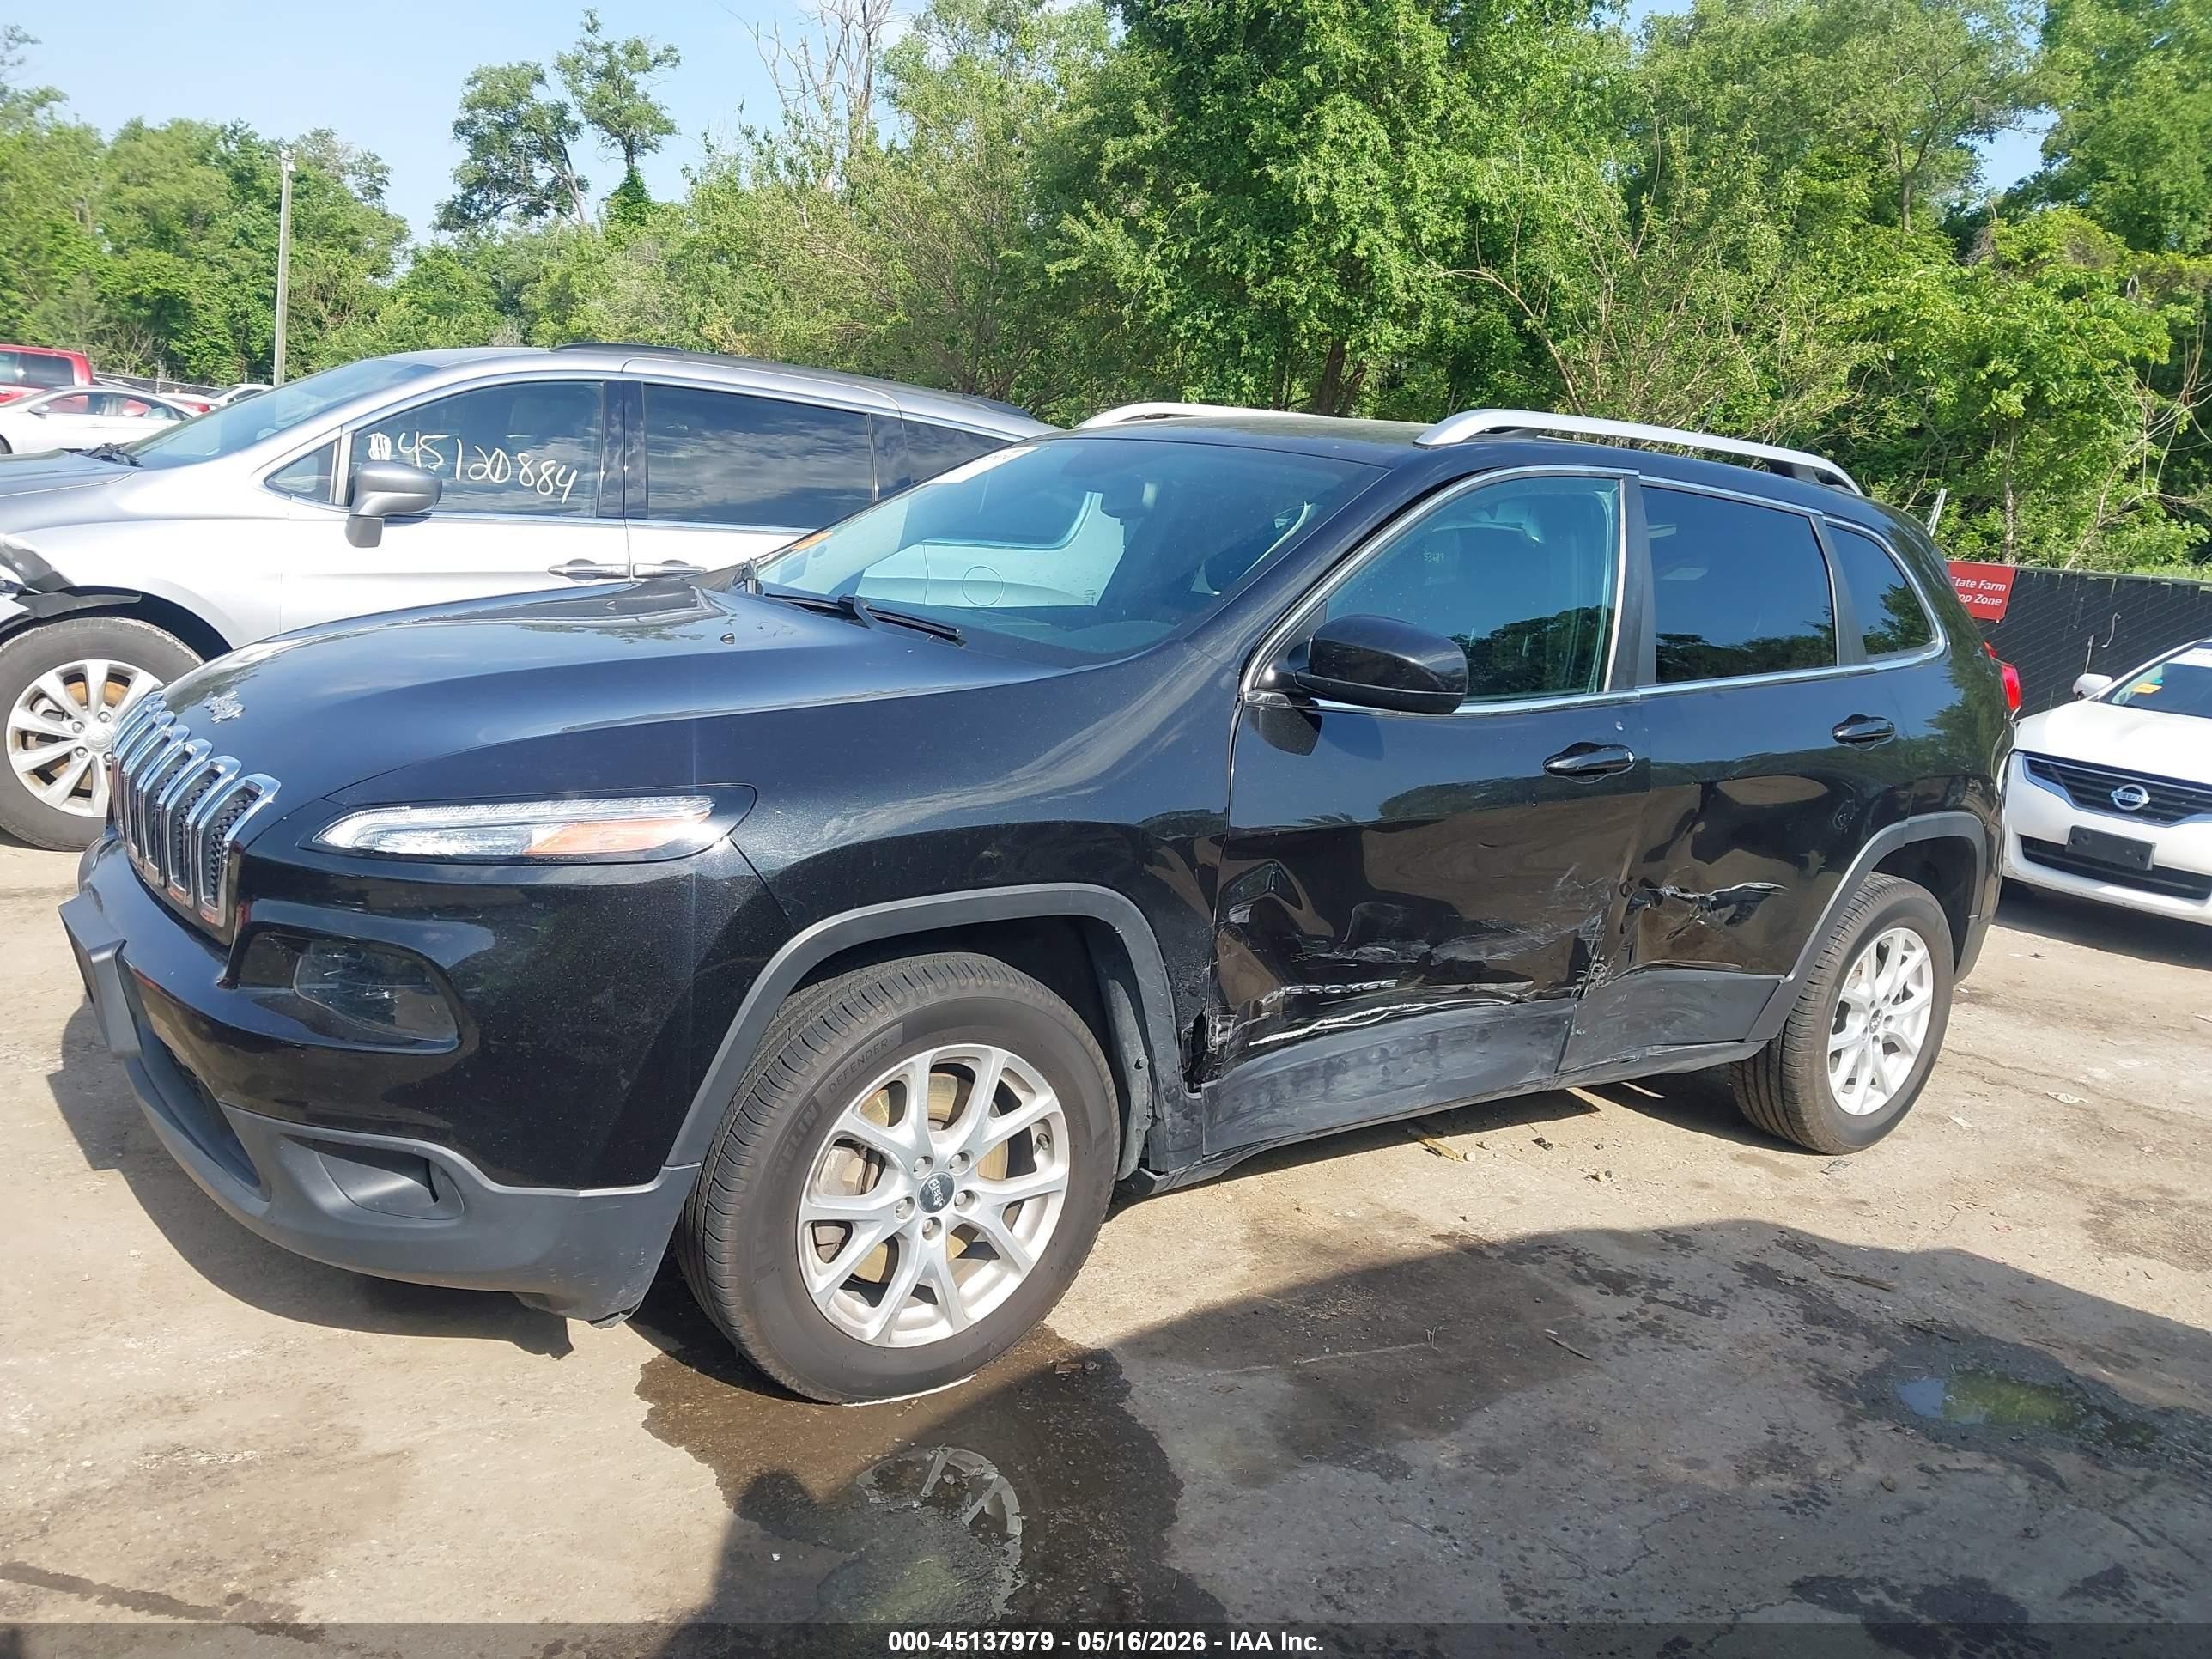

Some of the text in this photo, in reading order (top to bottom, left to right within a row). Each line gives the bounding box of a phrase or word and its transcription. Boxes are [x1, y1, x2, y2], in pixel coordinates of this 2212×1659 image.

[1978, 580, 2006, 592] Farm
[1974, 594, 2002, 606] Zone
[828, 1040, 888, 1095] DEFENDER
[927, 1178, 945, 1207] Jeep
